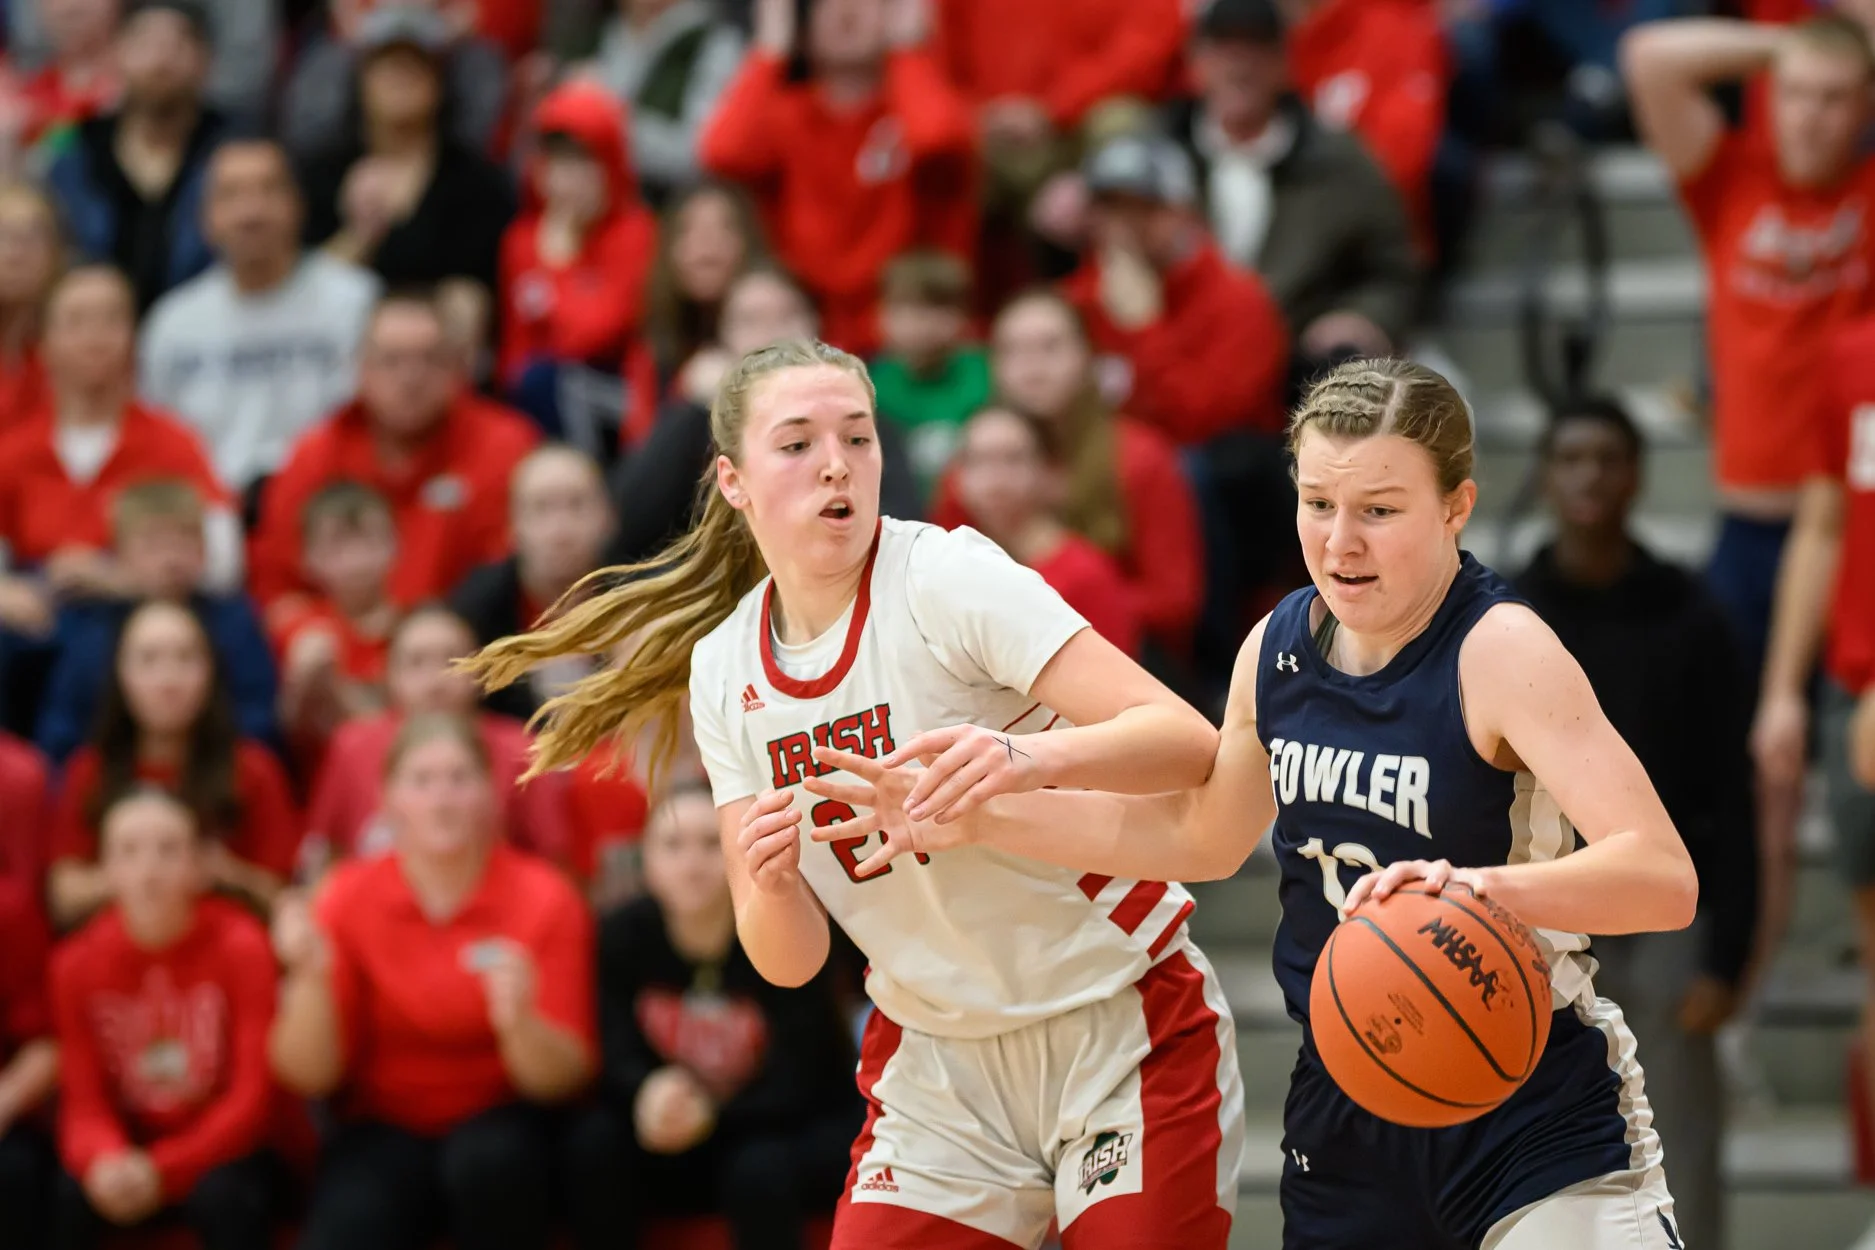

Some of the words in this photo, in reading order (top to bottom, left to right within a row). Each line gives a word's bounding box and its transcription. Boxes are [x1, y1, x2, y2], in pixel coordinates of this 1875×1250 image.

[766, 702, 896, 790] IRISH
[1269, 737, 1433, 839] FOWLER
[1078, 1132, 1134, 1190] IRISH
